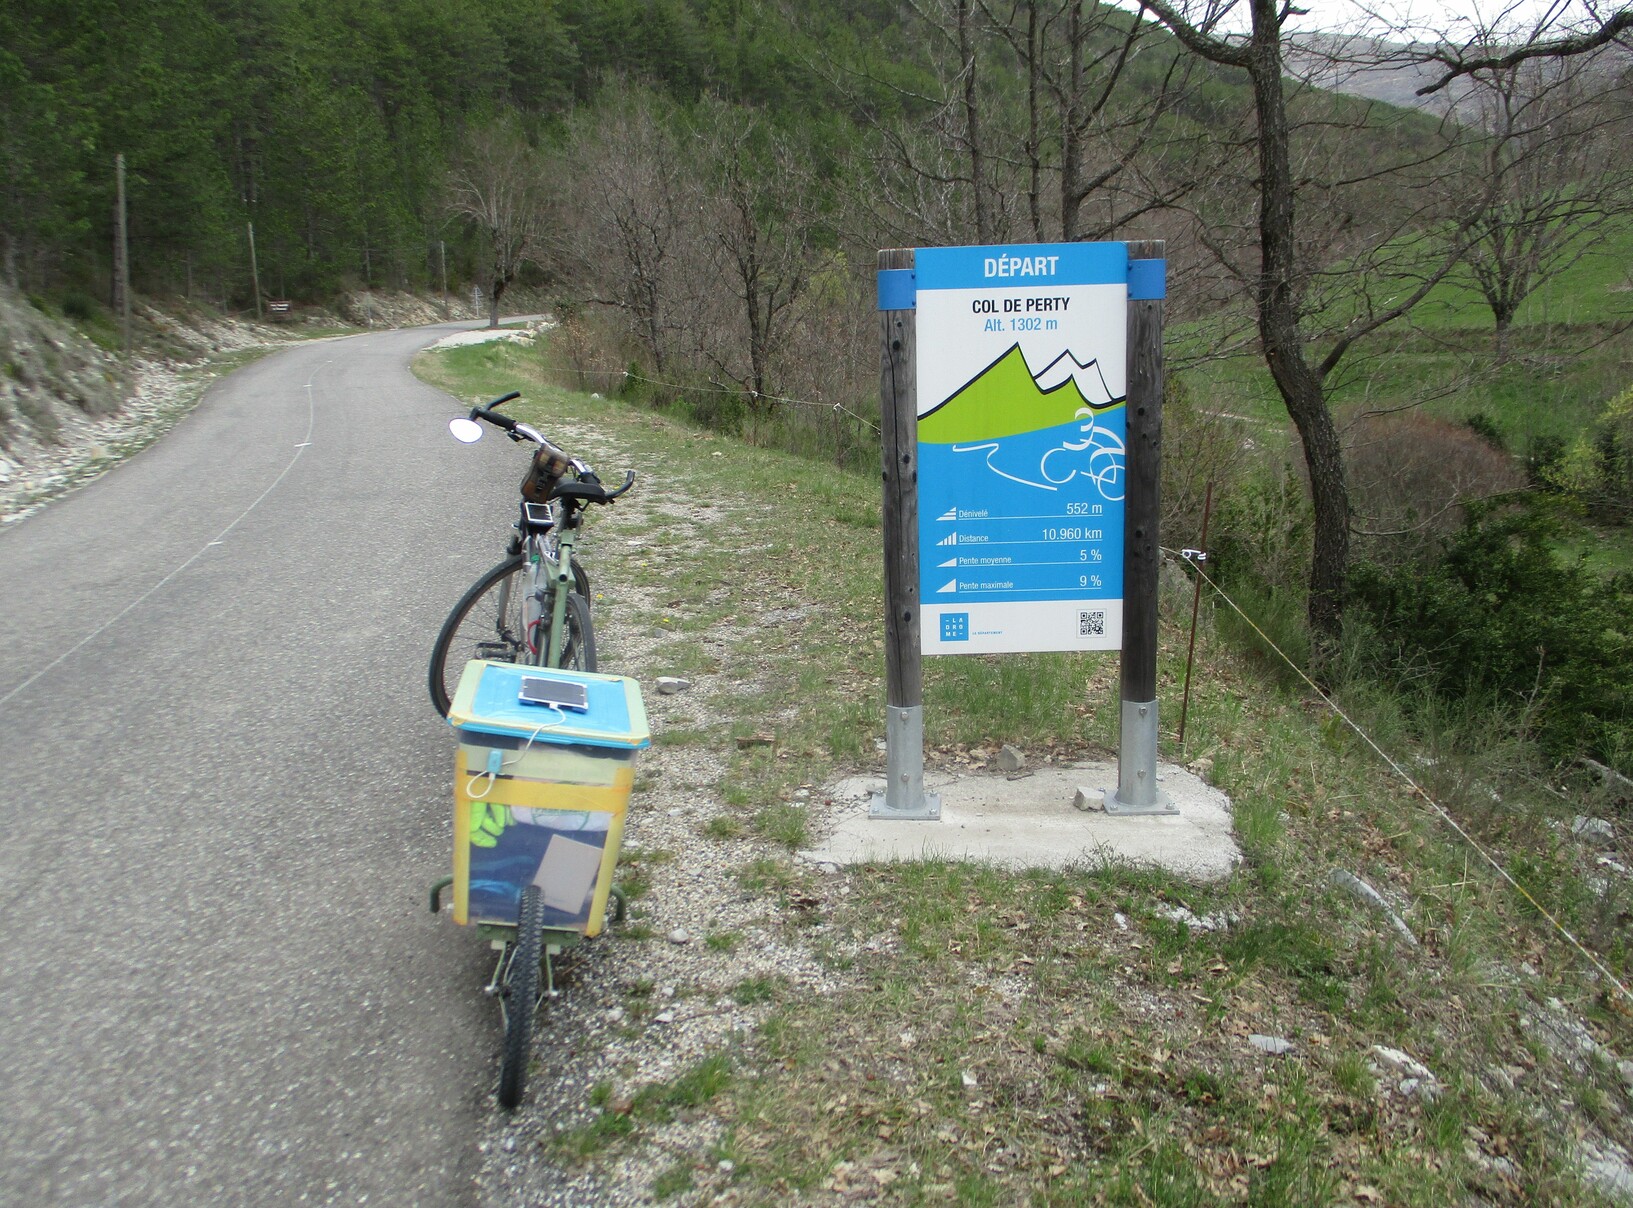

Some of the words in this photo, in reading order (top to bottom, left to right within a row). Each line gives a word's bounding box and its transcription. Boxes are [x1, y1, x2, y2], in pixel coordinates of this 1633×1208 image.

[984, 253, 1059, 278] DÉPART
[972, 299, 999, 313] COL
[1003, 299, 1021, 313] DE
[1026, 297, 1070, 312] PERTY
[984, 319, 1005, 332] Alt.
[1010, 317, 1042, 331] 1302
[1046, 319, 1058, 330] m
[958, 509, 988, 518] Dénivelé
[1066, 502, 1088, 515] 552
[1091, 503, 1103, 514] m
[959, 534, 989, 543] Distance
[1042, 527, 1081, 540] 10.960
[1084, 527, 1102, 539] km
[959, 556, 979, 565] Pente
[980, 557, 1012, 566] moyenne
[1080, 549, 1087, 561] 5
[1090, 548, 1102, 561] %
[959, 582, 979, 590] Pente
[980, 581, 1014, 589] maximale
[1079, 575, 1087, 587] 9
[1090, 574, 1102, 587] %
